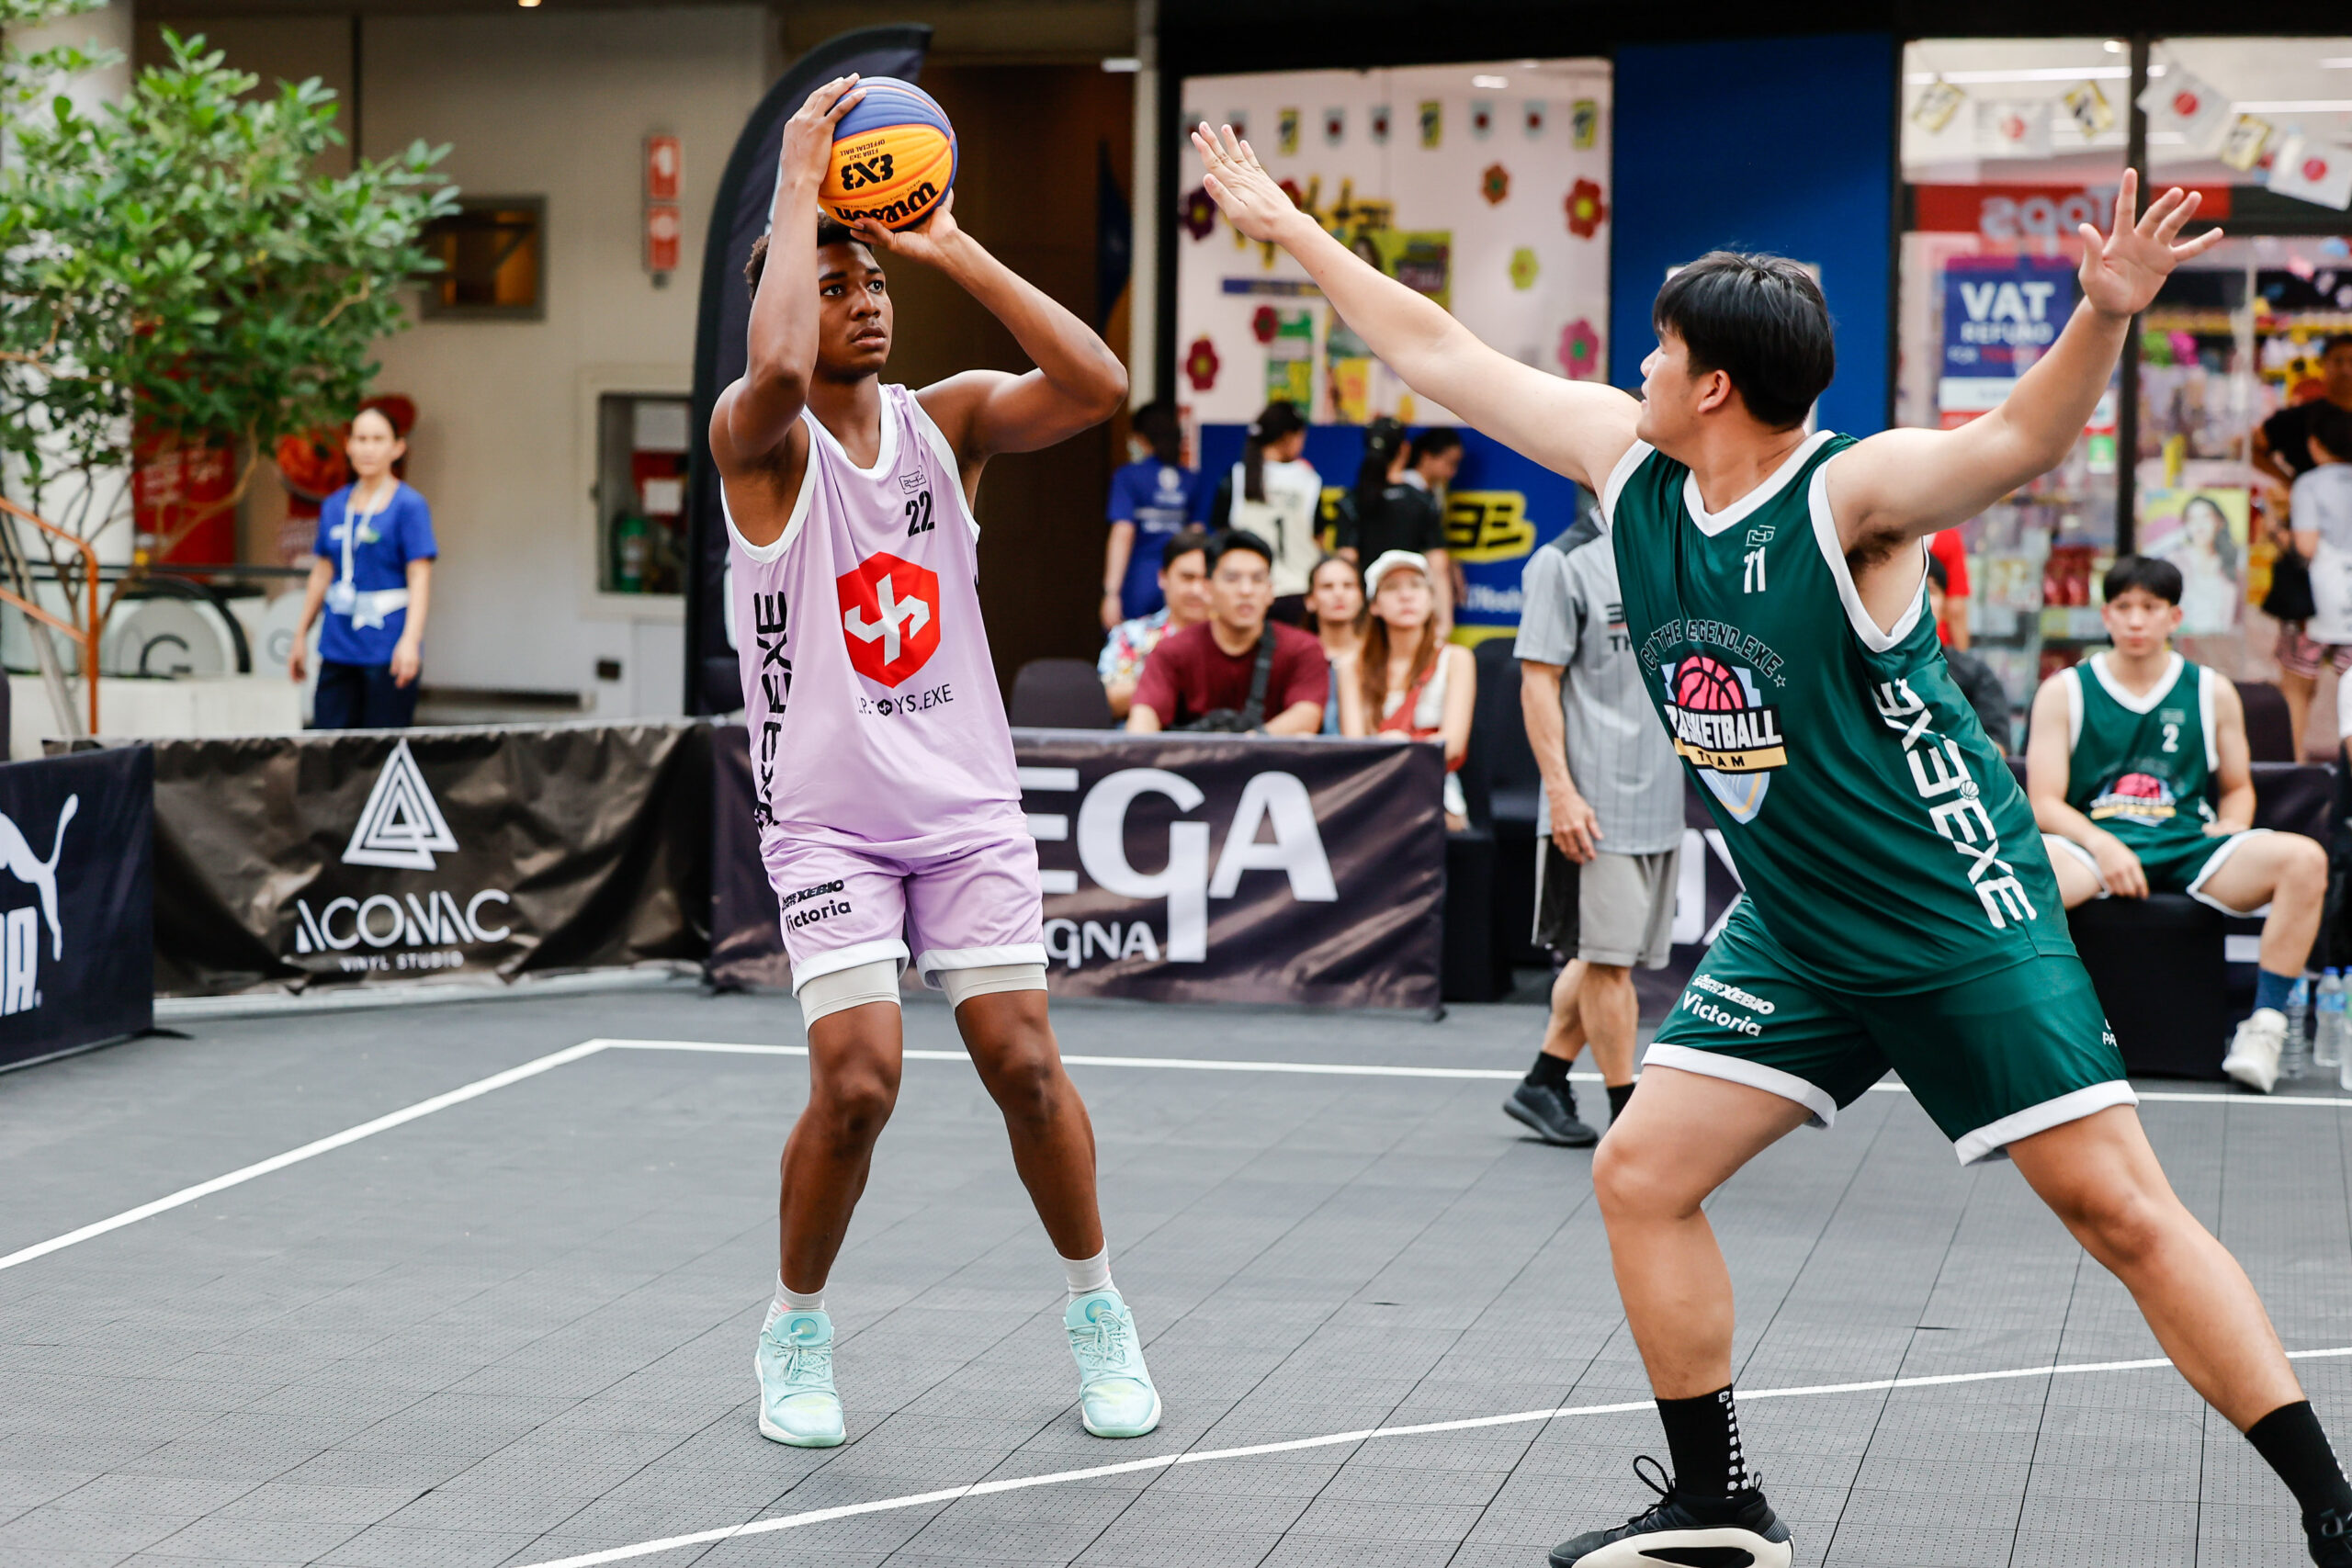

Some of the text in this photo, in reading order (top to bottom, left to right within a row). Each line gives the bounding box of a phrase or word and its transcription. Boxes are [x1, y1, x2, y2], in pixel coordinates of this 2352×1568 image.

[840, 139, 886, 156] OFFICIAL BALL
[834, 181, 939, 223] Wilson
[1960, 281, 2055, 321] VAT
[905, 490, 935, 537] 22
[1743, 546, 1766, 594] 11
[1651, 619, 1683, 653] THE
[1686, 619, 1785, 679] EGEND.EXE
[2162, 723, 2180, 753] 2
[1698, 750, 1746, 767] TAM
[1017, 766, 1339, 964] EGA
[797, 879, 844, 903] XEBIO
[786, 899, 852, 935] ictoria
[338, 950, 465, 973] VINYL STUDIO
[1044, 918, 1160, 969] GNA
[1682, 990, 1762, 1037] Victoria
[1718, 984, 1775, 1015] XEBIO
